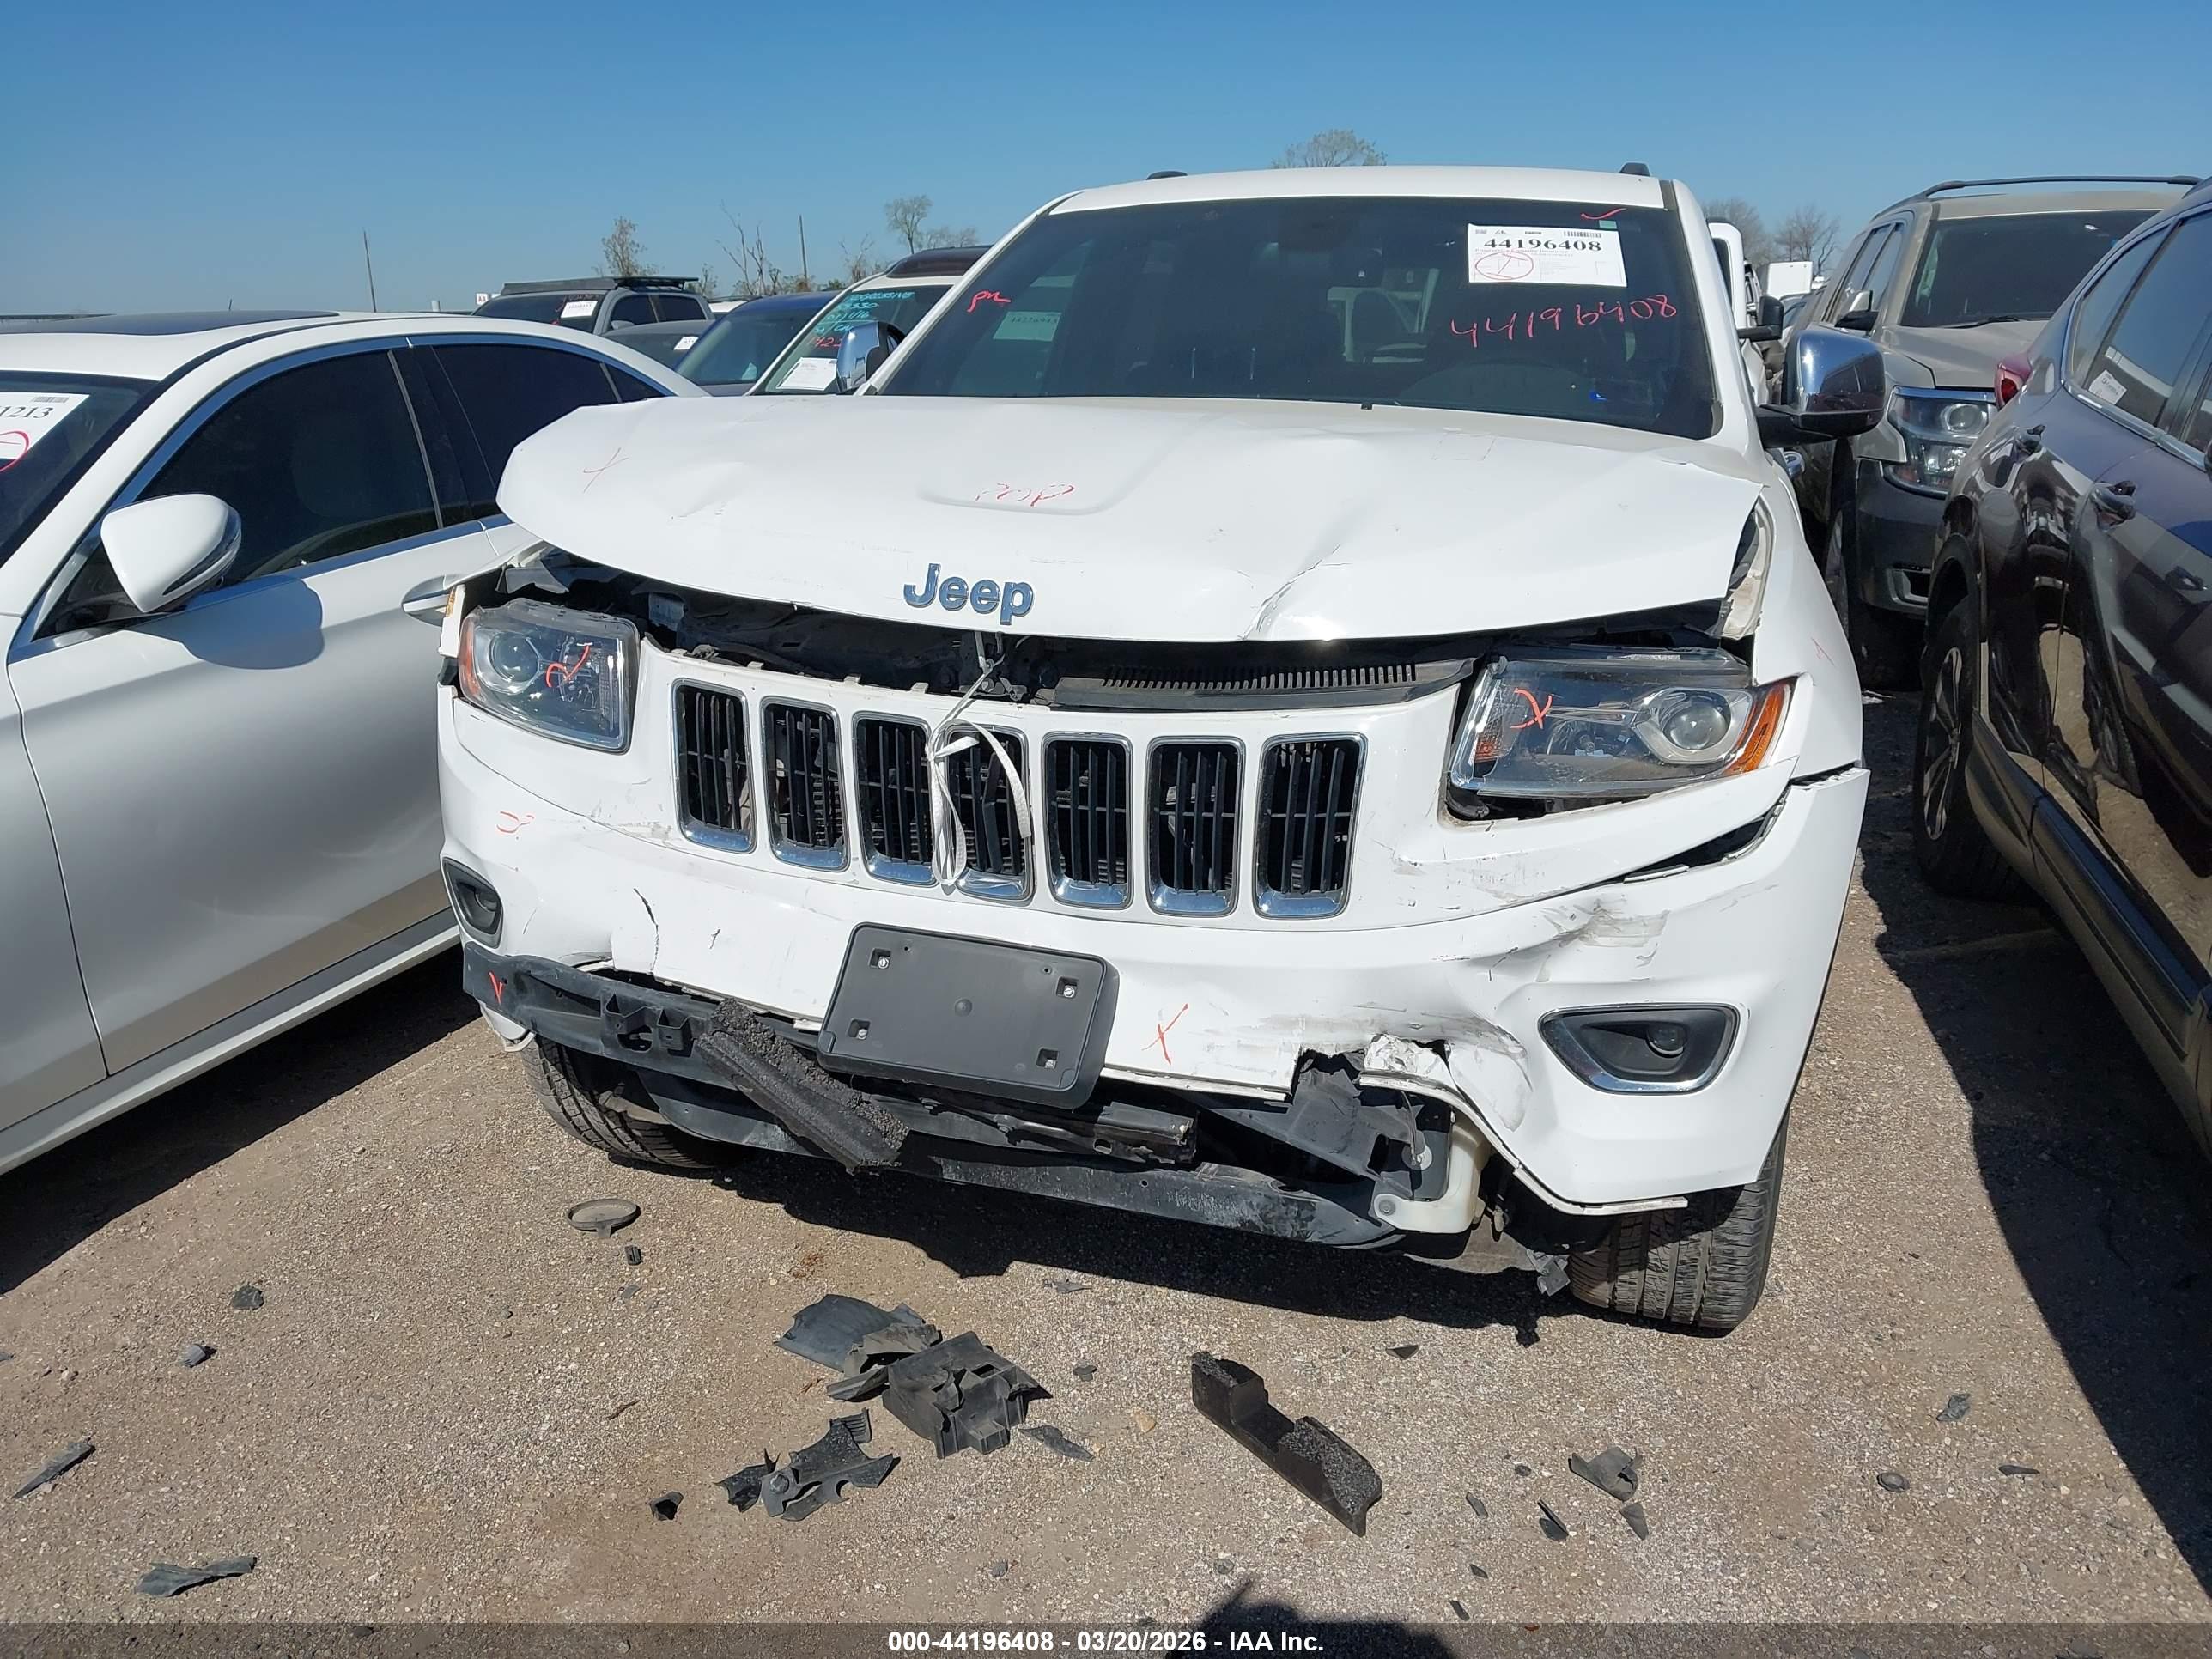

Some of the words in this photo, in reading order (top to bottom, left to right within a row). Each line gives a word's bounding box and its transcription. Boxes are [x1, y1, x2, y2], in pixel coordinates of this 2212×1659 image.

[1483, 238, 1603, 252] 44196408
[1450, 294, 1677, 349] 44196408
[0, 405, 54, 419] 1213
[903, 563, 1034, 626] Jeep
